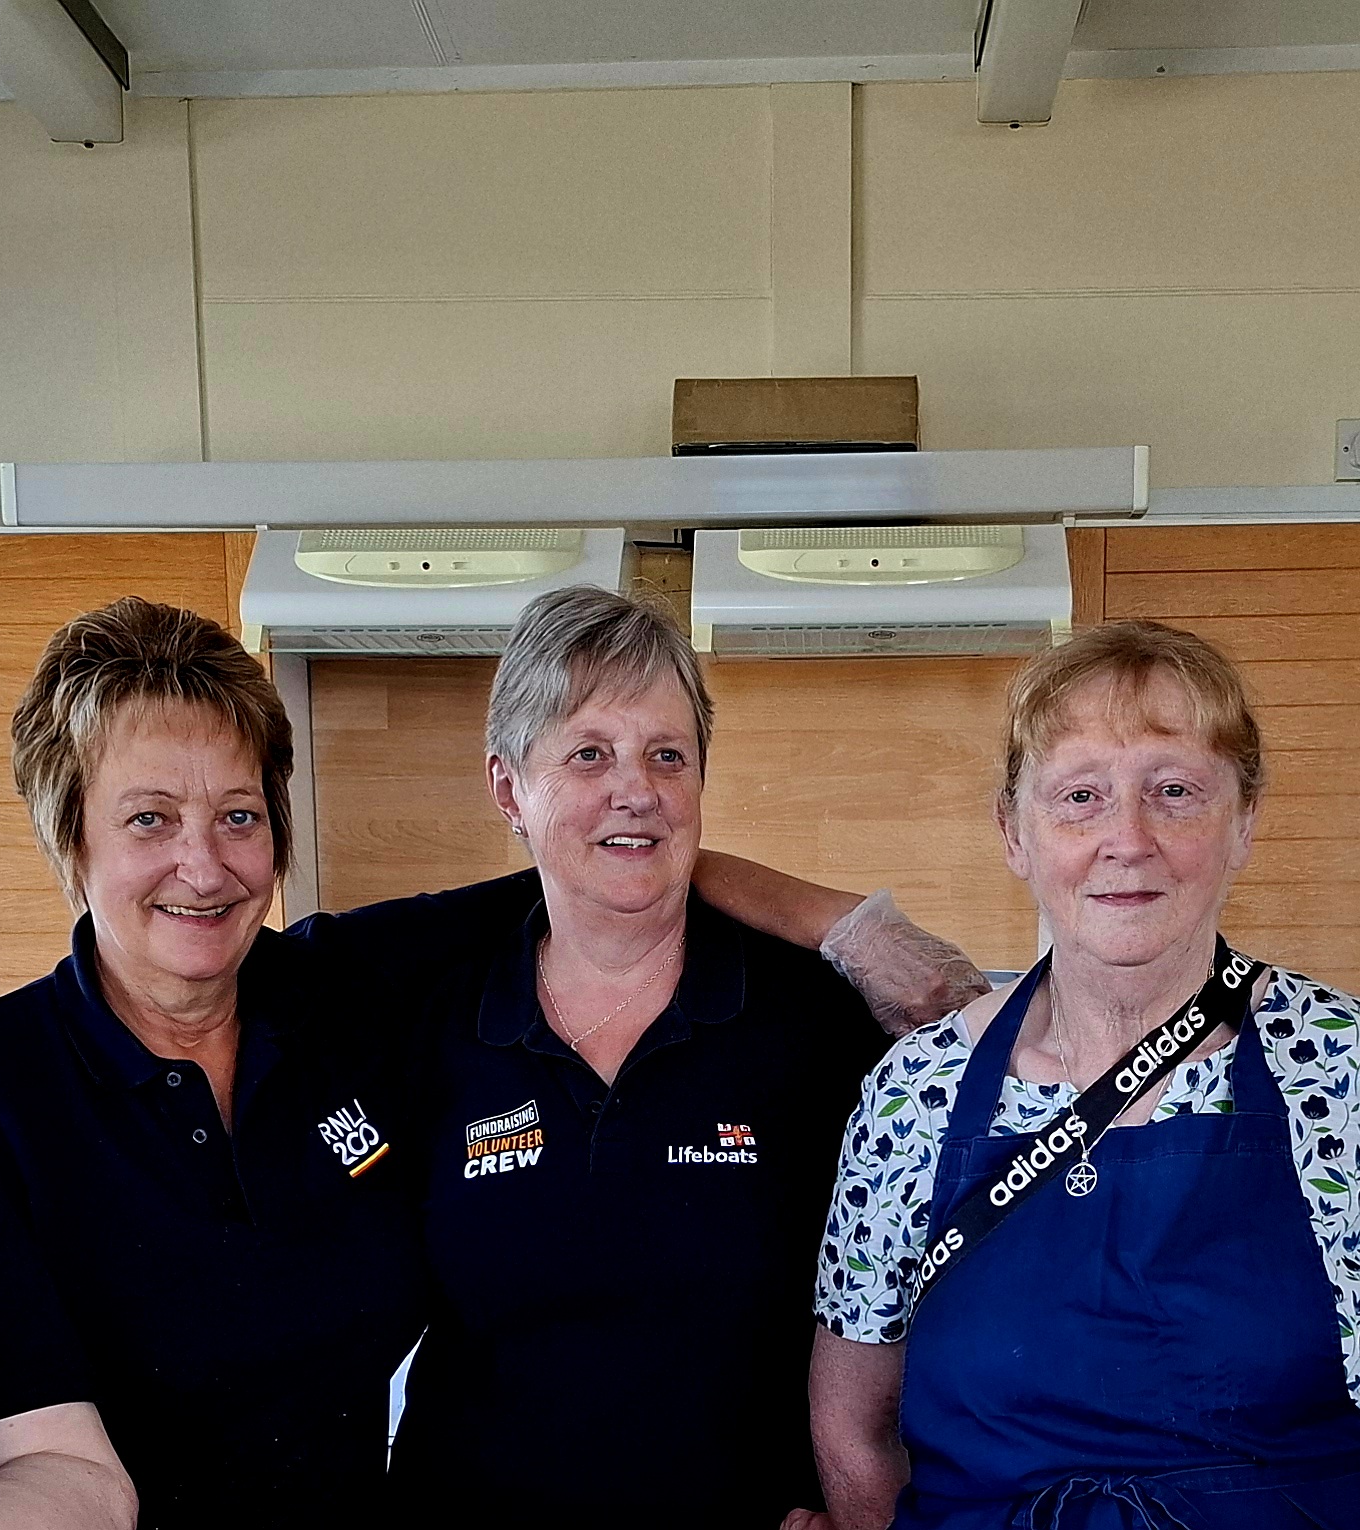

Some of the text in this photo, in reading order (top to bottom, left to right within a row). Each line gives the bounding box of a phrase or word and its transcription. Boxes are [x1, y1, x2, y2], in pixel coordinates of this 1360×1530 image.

[1222, 950, 1256, 990] adi
[1115, 1006, 1206, 1094] adidas
[318, 1098, 367, 1145] RNLI
[469, 1106, 536, 1141] FUNDRAISING
[464, 1146, 544, 1179] CREW
[467, 1129, 544, 1160] VOLUNTEER
[667, 1145, 758, 1163] Lifeboats
[989, 1112, 1088, 1207] adidas
